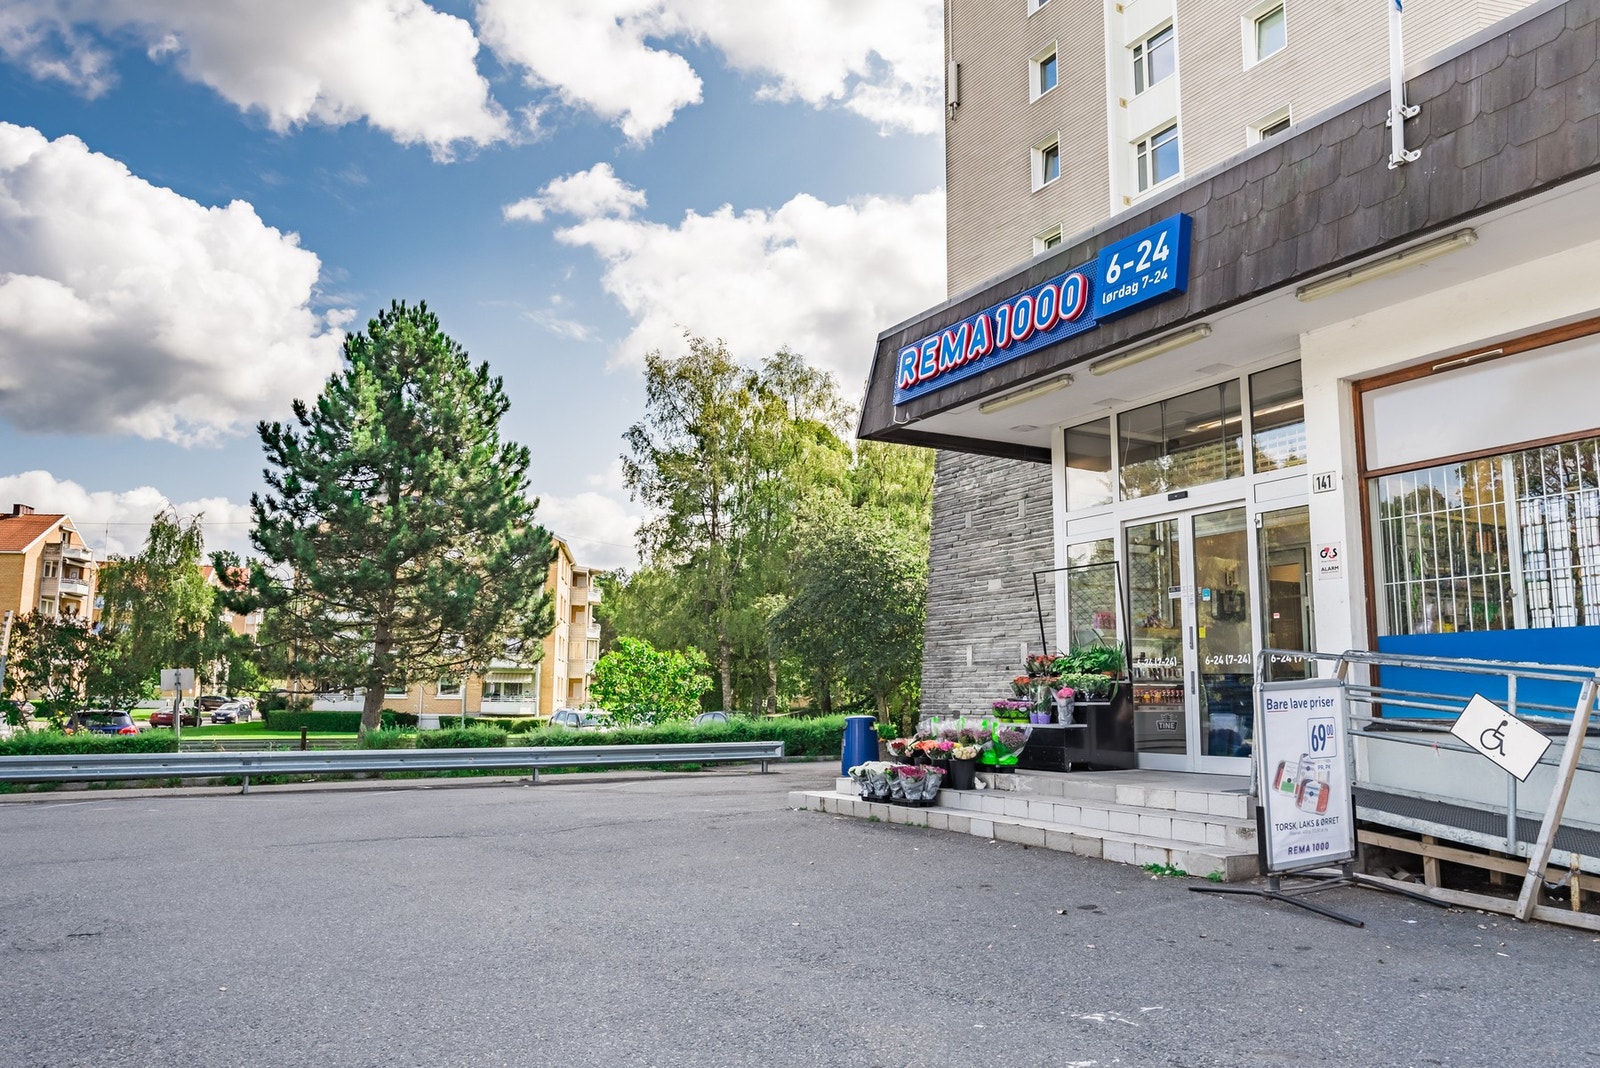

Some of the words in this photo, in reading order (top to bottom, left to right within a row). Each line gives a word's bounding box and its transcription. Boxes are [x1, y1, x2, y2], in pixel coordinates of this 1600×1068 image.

[1106, 230, 1170, 285] 6-24
[1102, 282, 1139, 305] lørdag
[1142, 266, 1168, 289] 7-24
[898, 314, 994, 389] REMA
[995, 272, 1089, 350] 1000
[1316, 474, 1332, 491] 141
[1204, 655, 1224, 666] 6-24
[1225, 653, 1251, 665] (7-24)
[1266, 698, 1288, 710] Bare
[1290, 697, 1308, 709] lave
[1309, 695, 1335, 710] priser
[1311, 723, 1326, 752] 69
[1299, 819, 1315, 829] LAKS
[1315, 818, 1320, 827] &
[1320, 816, 1340, 826] ØRRET
[1288, 844, 1311, 855] REMA
[1312, 841, 1330, 852] 1000
